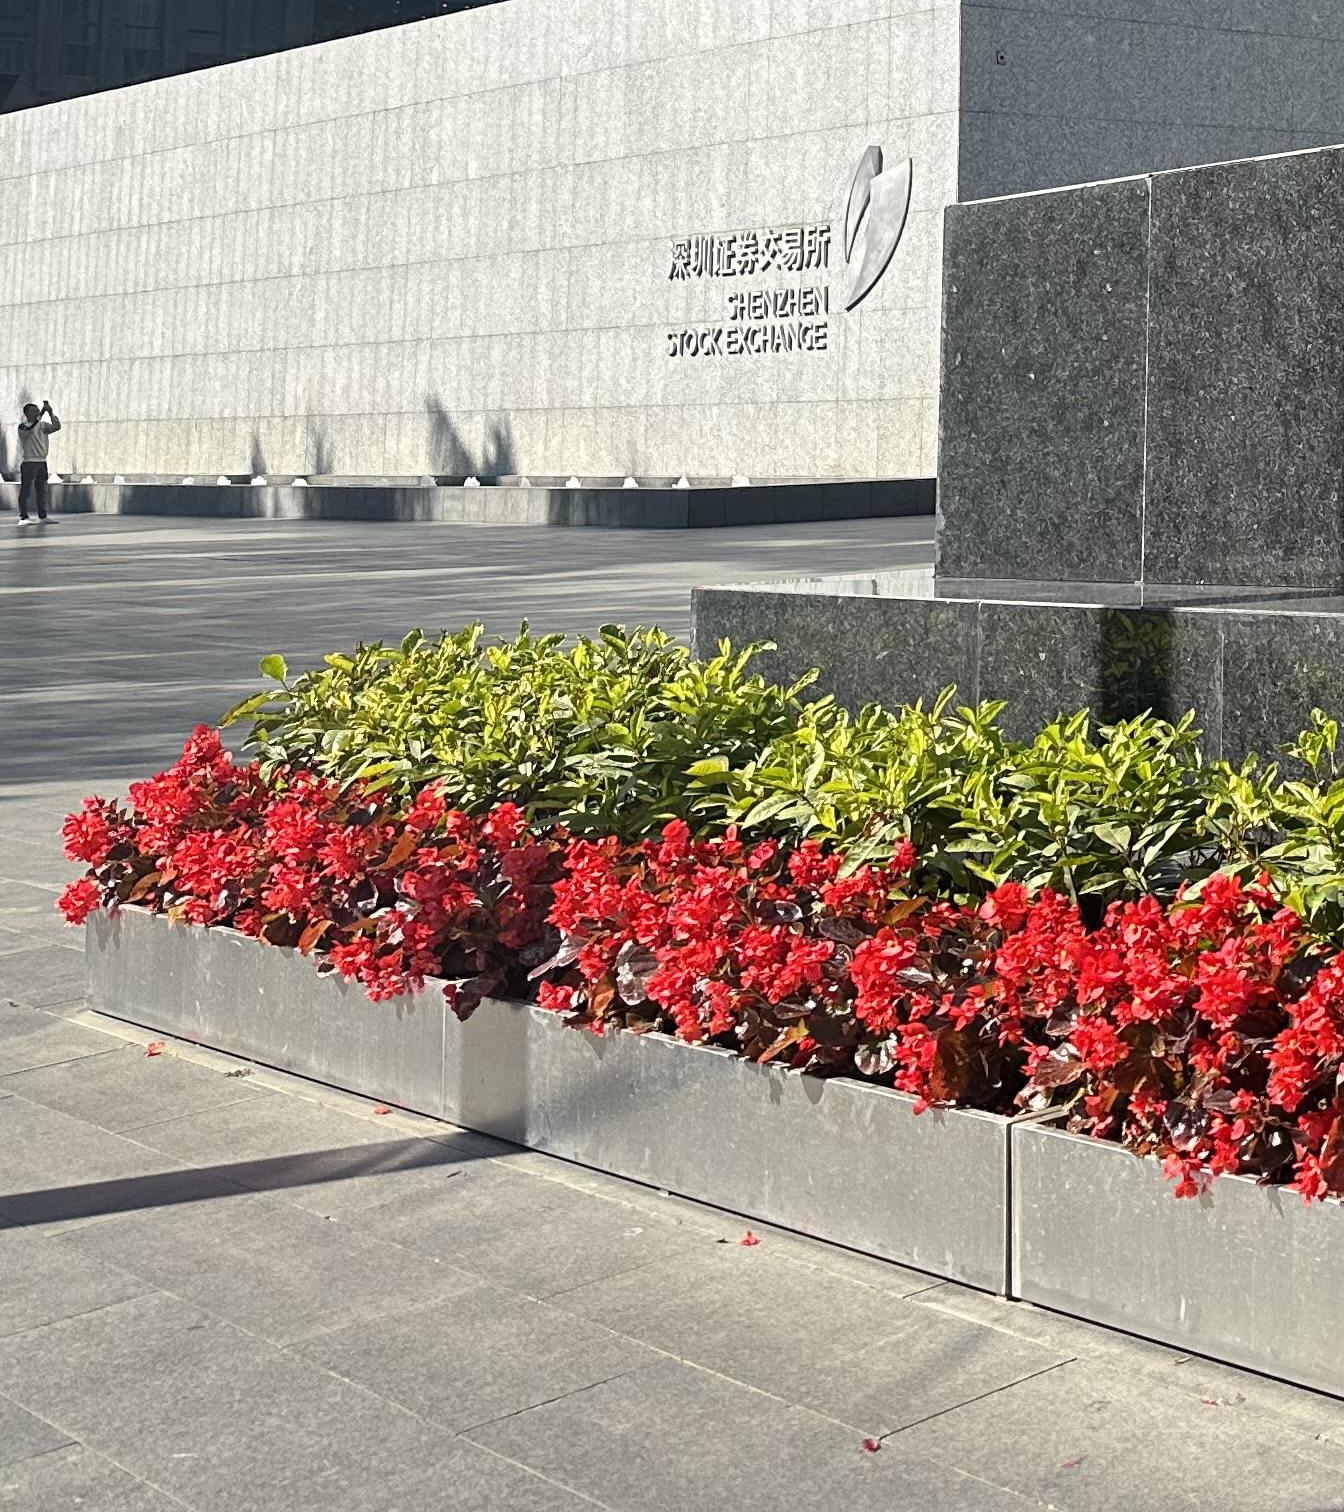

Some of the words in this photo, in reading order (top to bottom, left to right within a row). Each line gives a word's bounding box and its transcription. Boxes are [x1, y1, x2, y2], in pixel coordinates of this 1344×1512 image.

[668, 226, 831, 281] 深圳证券交易所
[728, 286, 829, 320] SHENZHEN
[668, 328, 722, 357] STOCK
[727, 322, 828, 355] EXCHANGE
